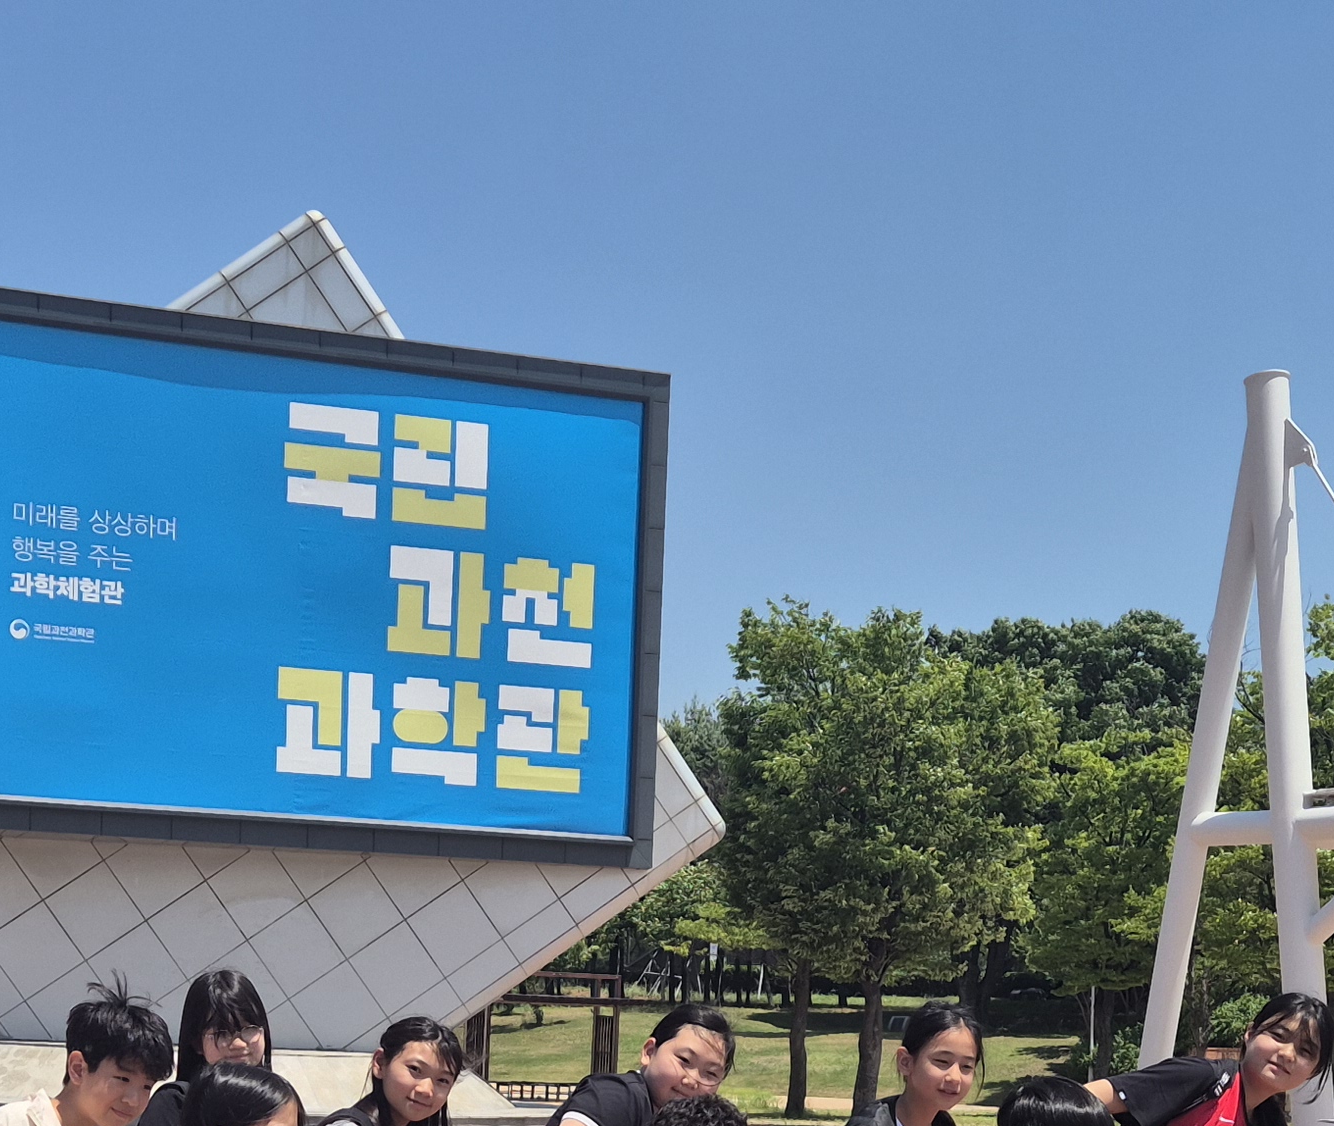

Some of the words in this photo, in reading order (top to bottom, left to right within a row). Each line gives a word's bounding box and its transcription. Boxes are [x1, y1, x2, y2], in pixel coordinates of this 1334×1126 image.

[283, 402, 490, 530] 국립
[12, 501, 80, 531] 미래를
[88, 509, 178, 541] 상상하며
[12, 536, 80, 566] 행복을
[87, 543, 133, 571] 주는
[9, 572, 125, 605] 과학체험관
[387, 544, 595, 669] 과천
[276, 665, 590, 794] 과학관
